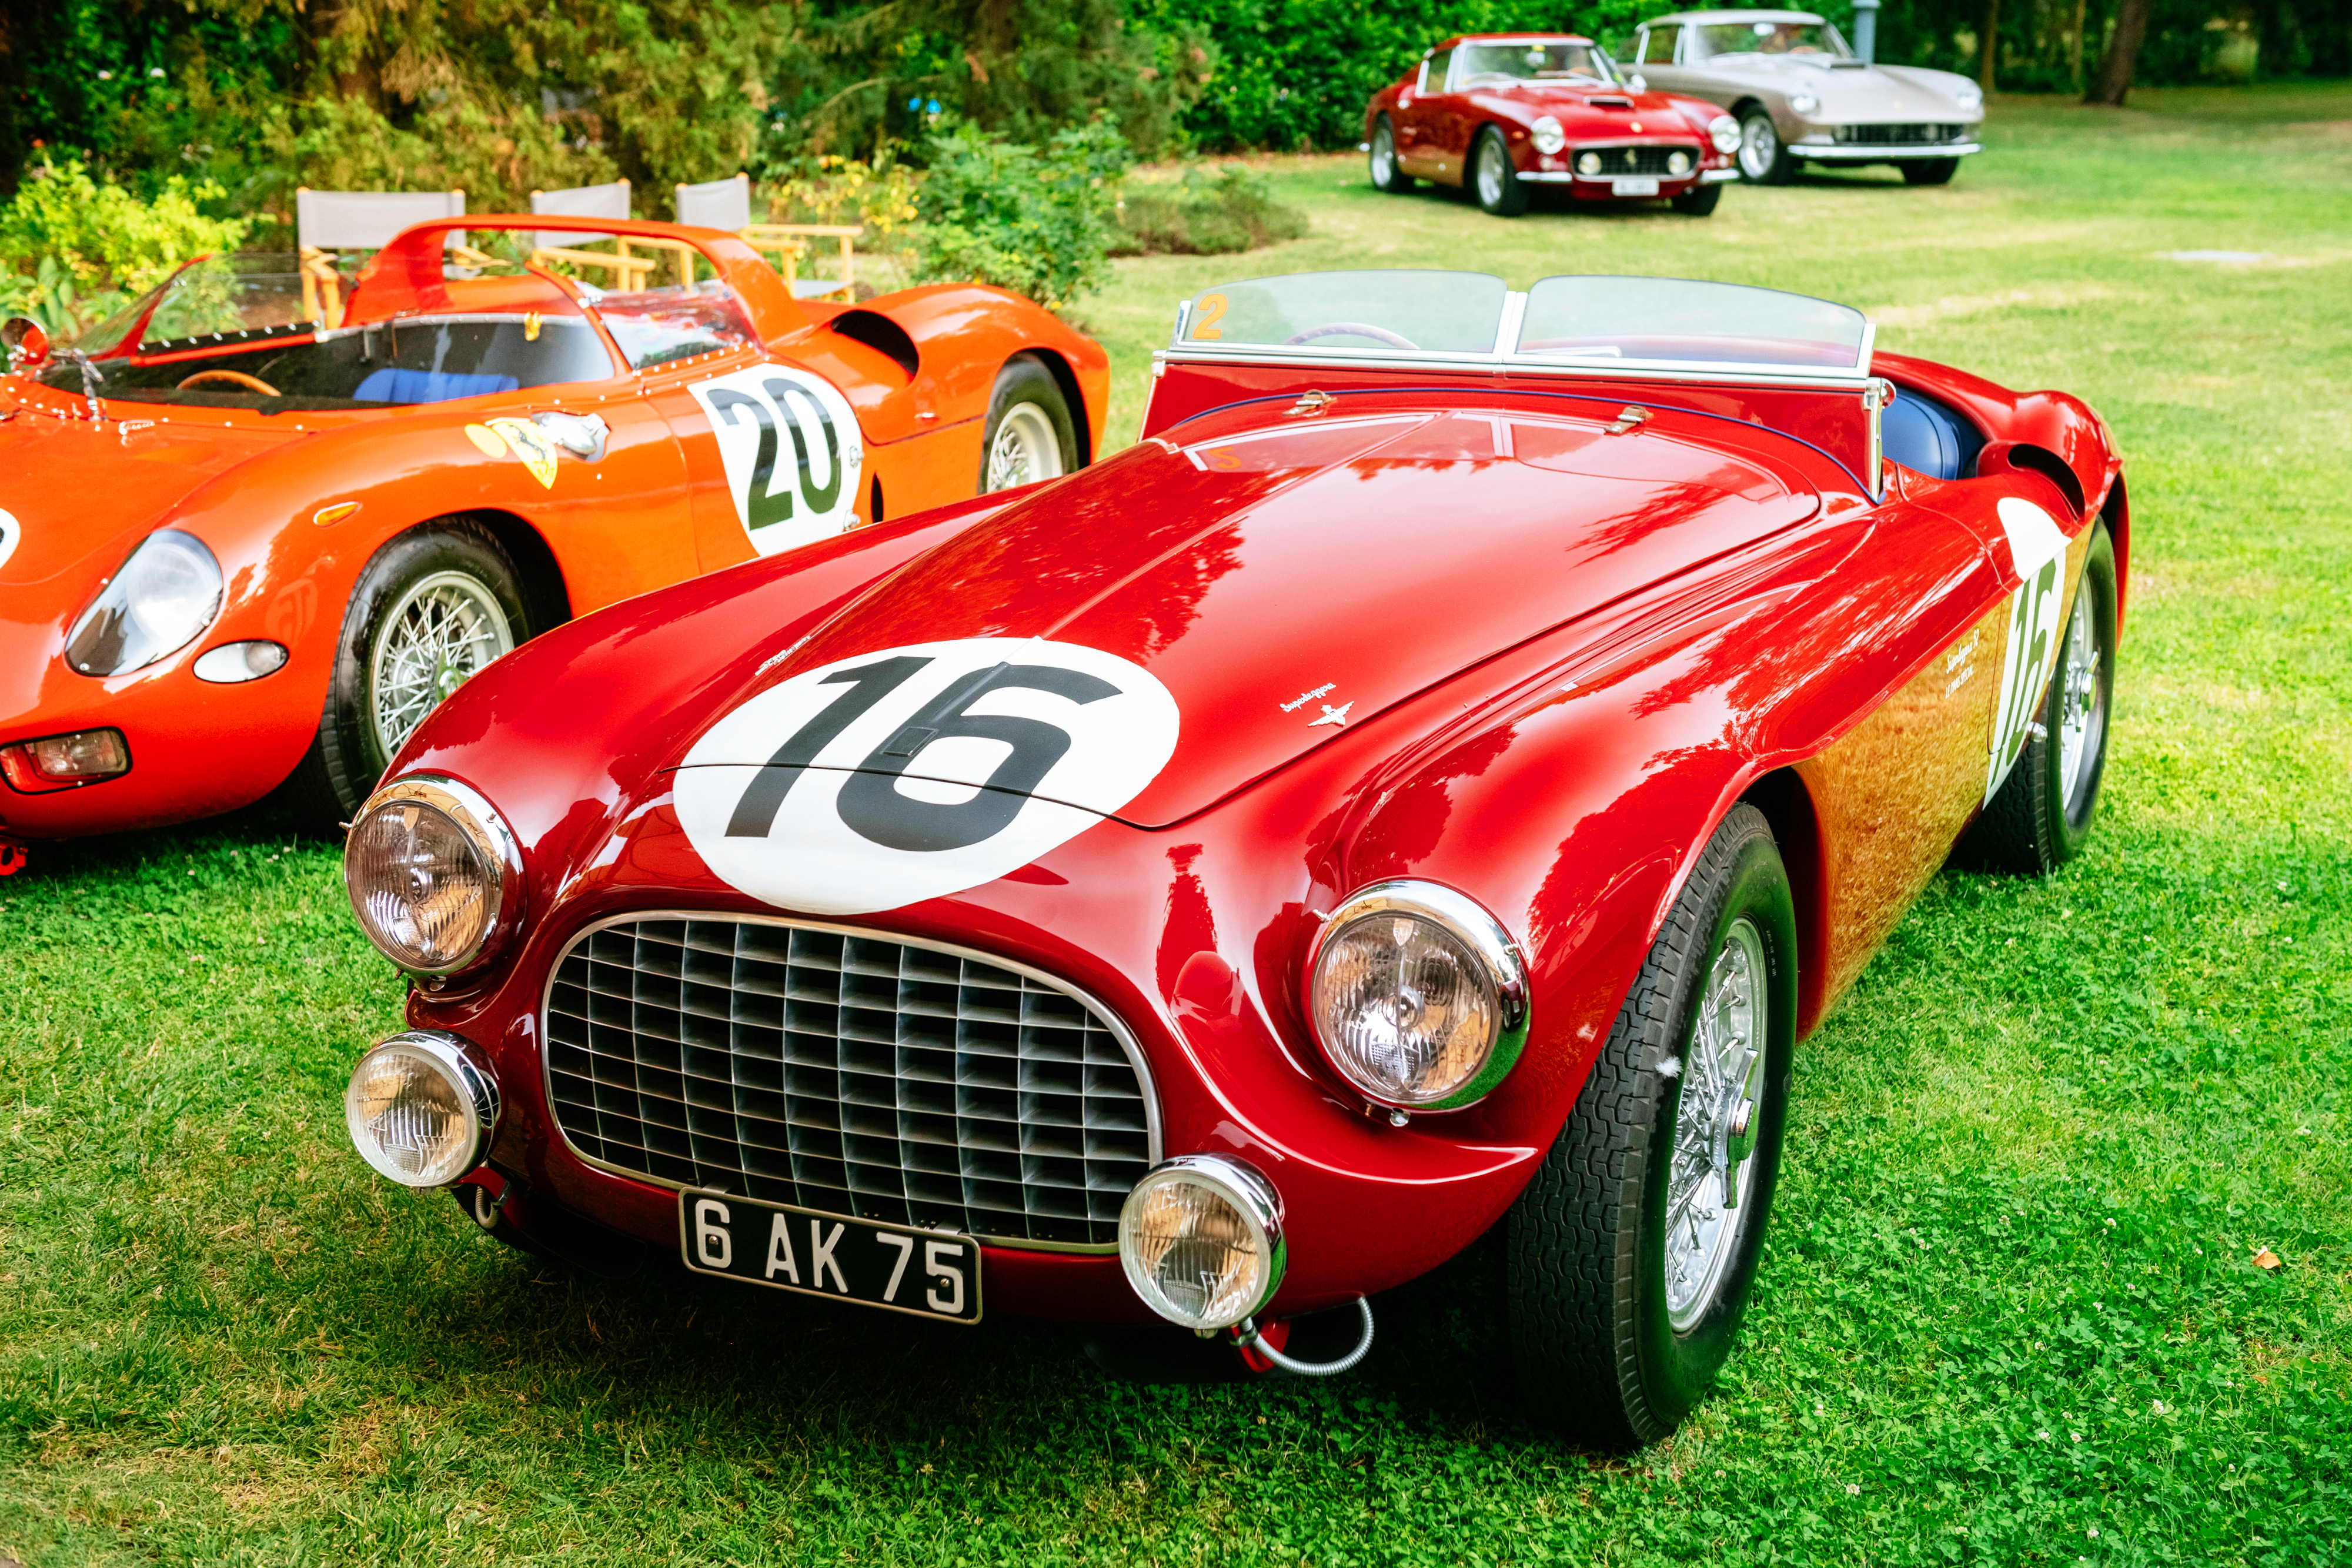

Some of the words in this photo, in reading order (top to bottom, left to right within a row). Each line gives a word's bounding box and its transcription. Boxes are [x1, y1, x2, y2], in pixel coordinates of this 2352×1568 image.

[1192, 293, 1228, 339] 2
[706, 378, 841, 530] 20
[1279, 682, 1337, 713] Superleggera
[1990, 558, 2057, 790] 16
[724, 655, 1123, 852] 16
[695, 1199, 731, 1269] 6
[765, 1213, 848, 1293] AK
[876, 1232, 964, 1314] 75
